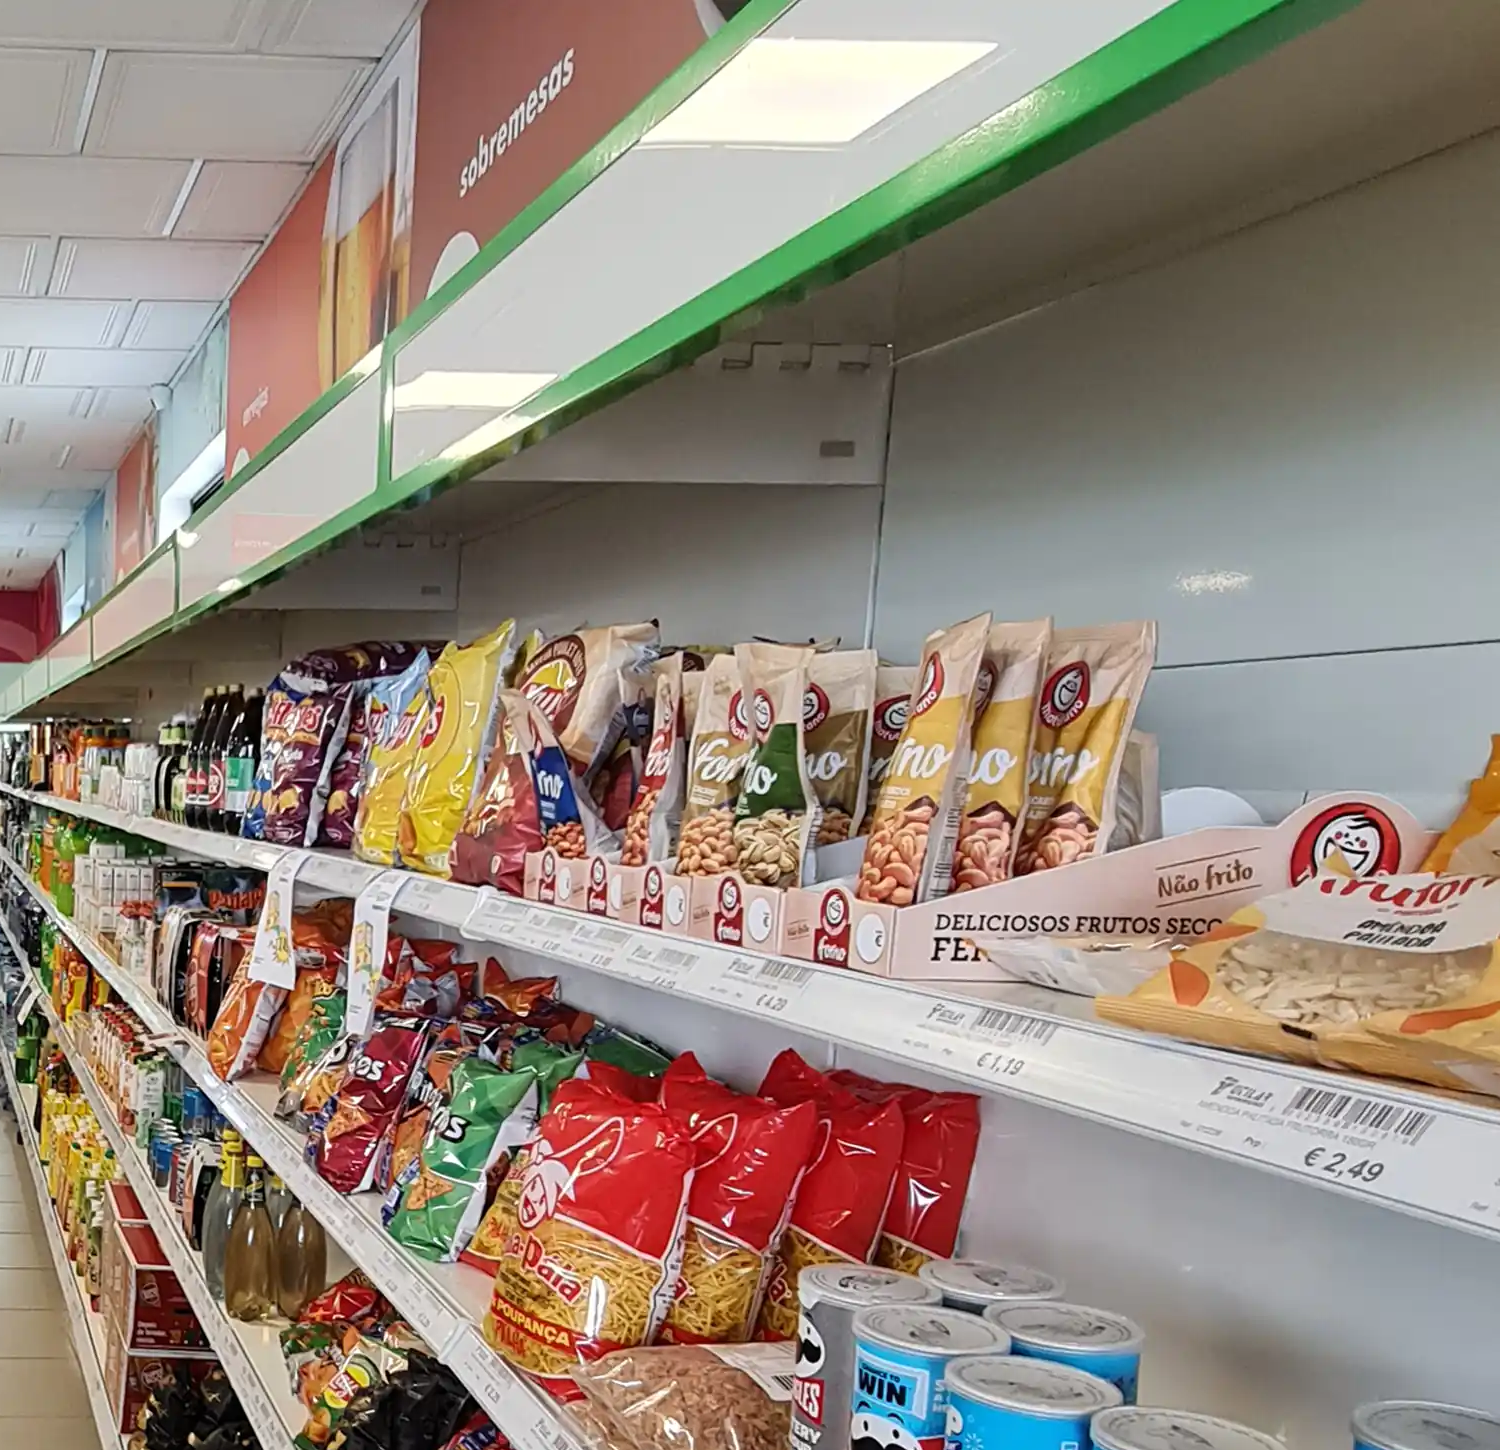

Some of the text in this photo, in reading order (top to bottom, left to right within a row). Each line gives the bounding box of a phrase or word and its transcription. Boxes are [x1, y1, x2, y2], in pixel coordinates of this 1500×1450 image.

[459, 47, 576, 198] sobremesas
[1157, 860, 1254, 899] Não frito
[935, 914, 1070, 933] DELICIOSOS
[1075, 915, 1161, 935] FRUTOS
[977, 1053, 1026, 1076] € 1,19
[1303, 1146, 1386, 1183] € 2,49
[496, 1299, 571, 1348] POUPANÇA
[858, 1367, 908, 1408] WIN
